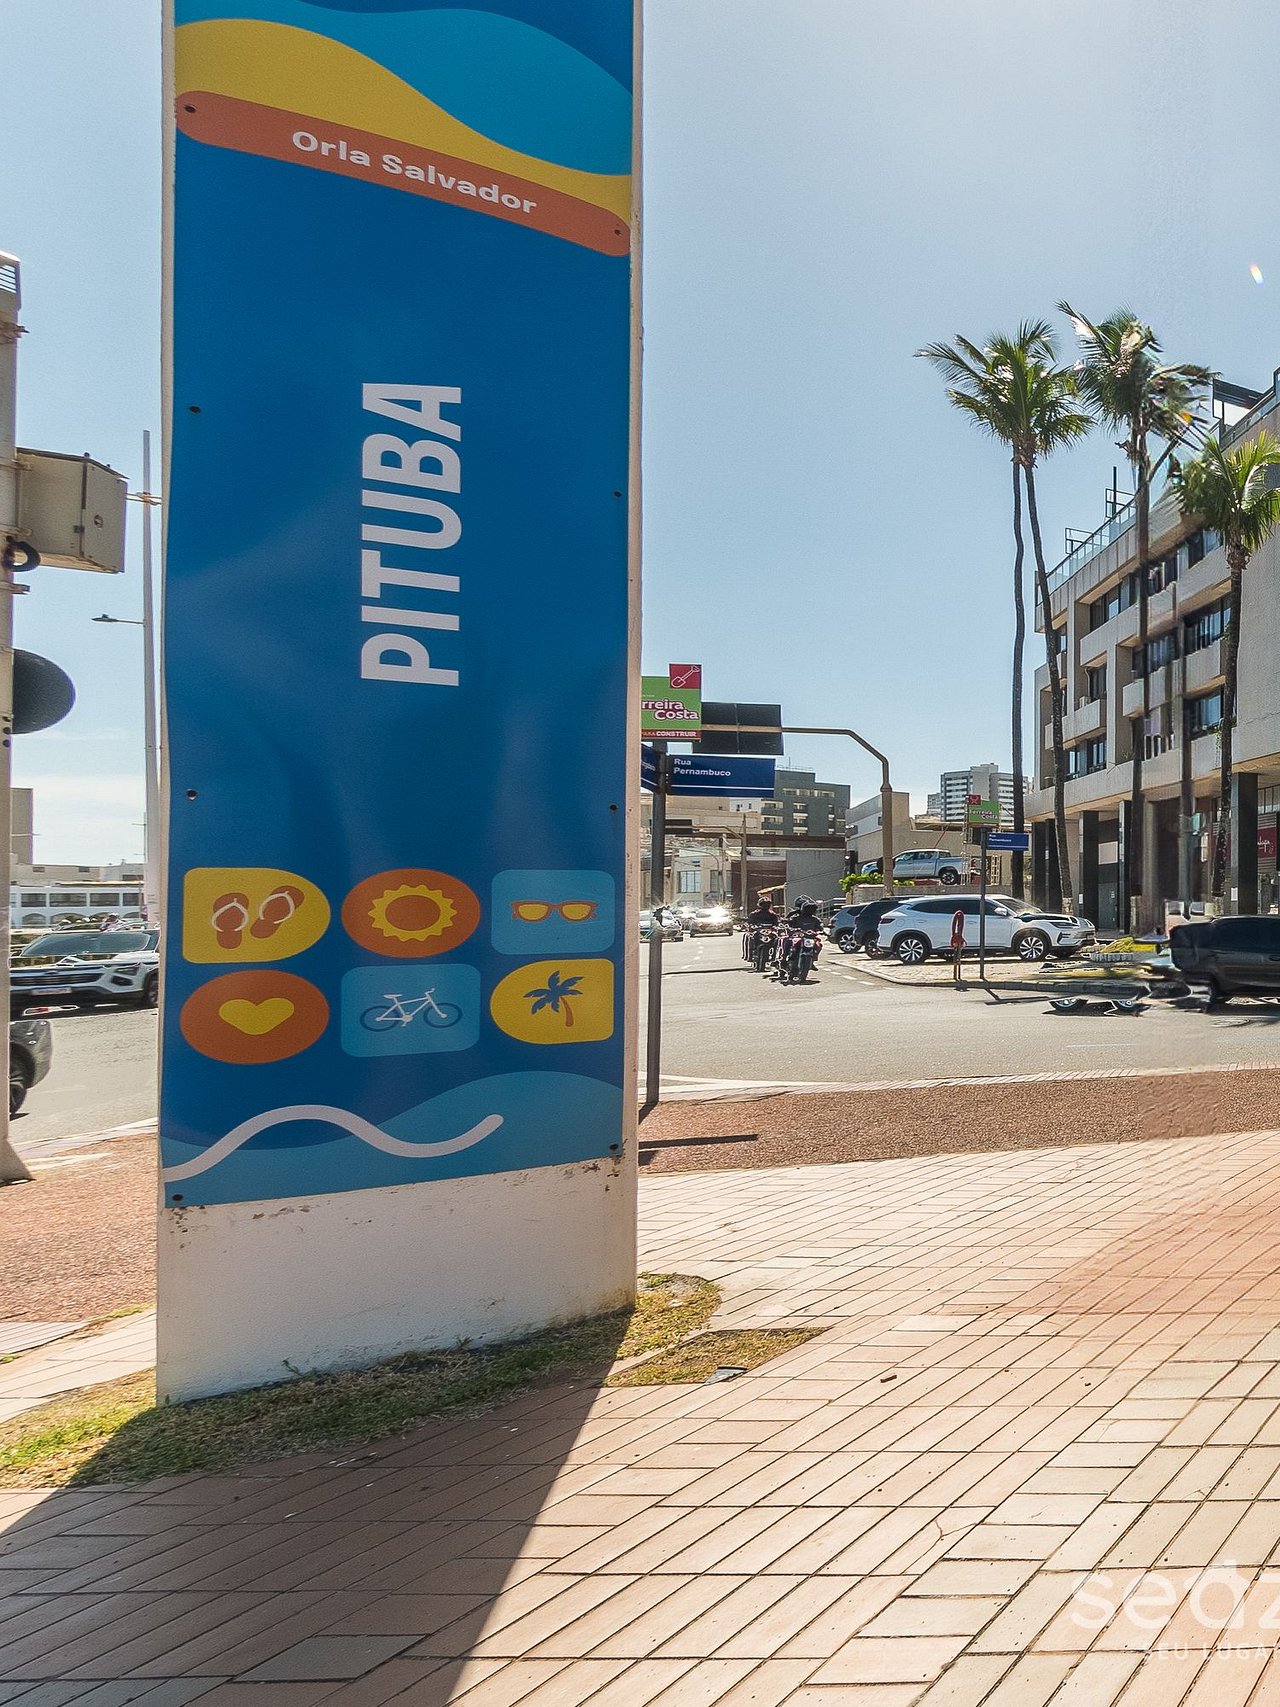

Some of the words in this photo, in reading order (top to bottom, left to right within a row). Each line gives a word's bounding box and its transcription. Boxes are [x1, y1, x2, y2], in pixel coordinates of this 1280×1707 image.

[292, 130, 370, 168] Orla
[382, 154, 537, 215] Salvador
[360, 382, 462, 687] PITUBA
[642, 699, 684, 710] rreira
[655, 710, 699, 720] Costa
[674, 758, 691, 766] Rua
[674, 767, 732, 777] Pernambuco
